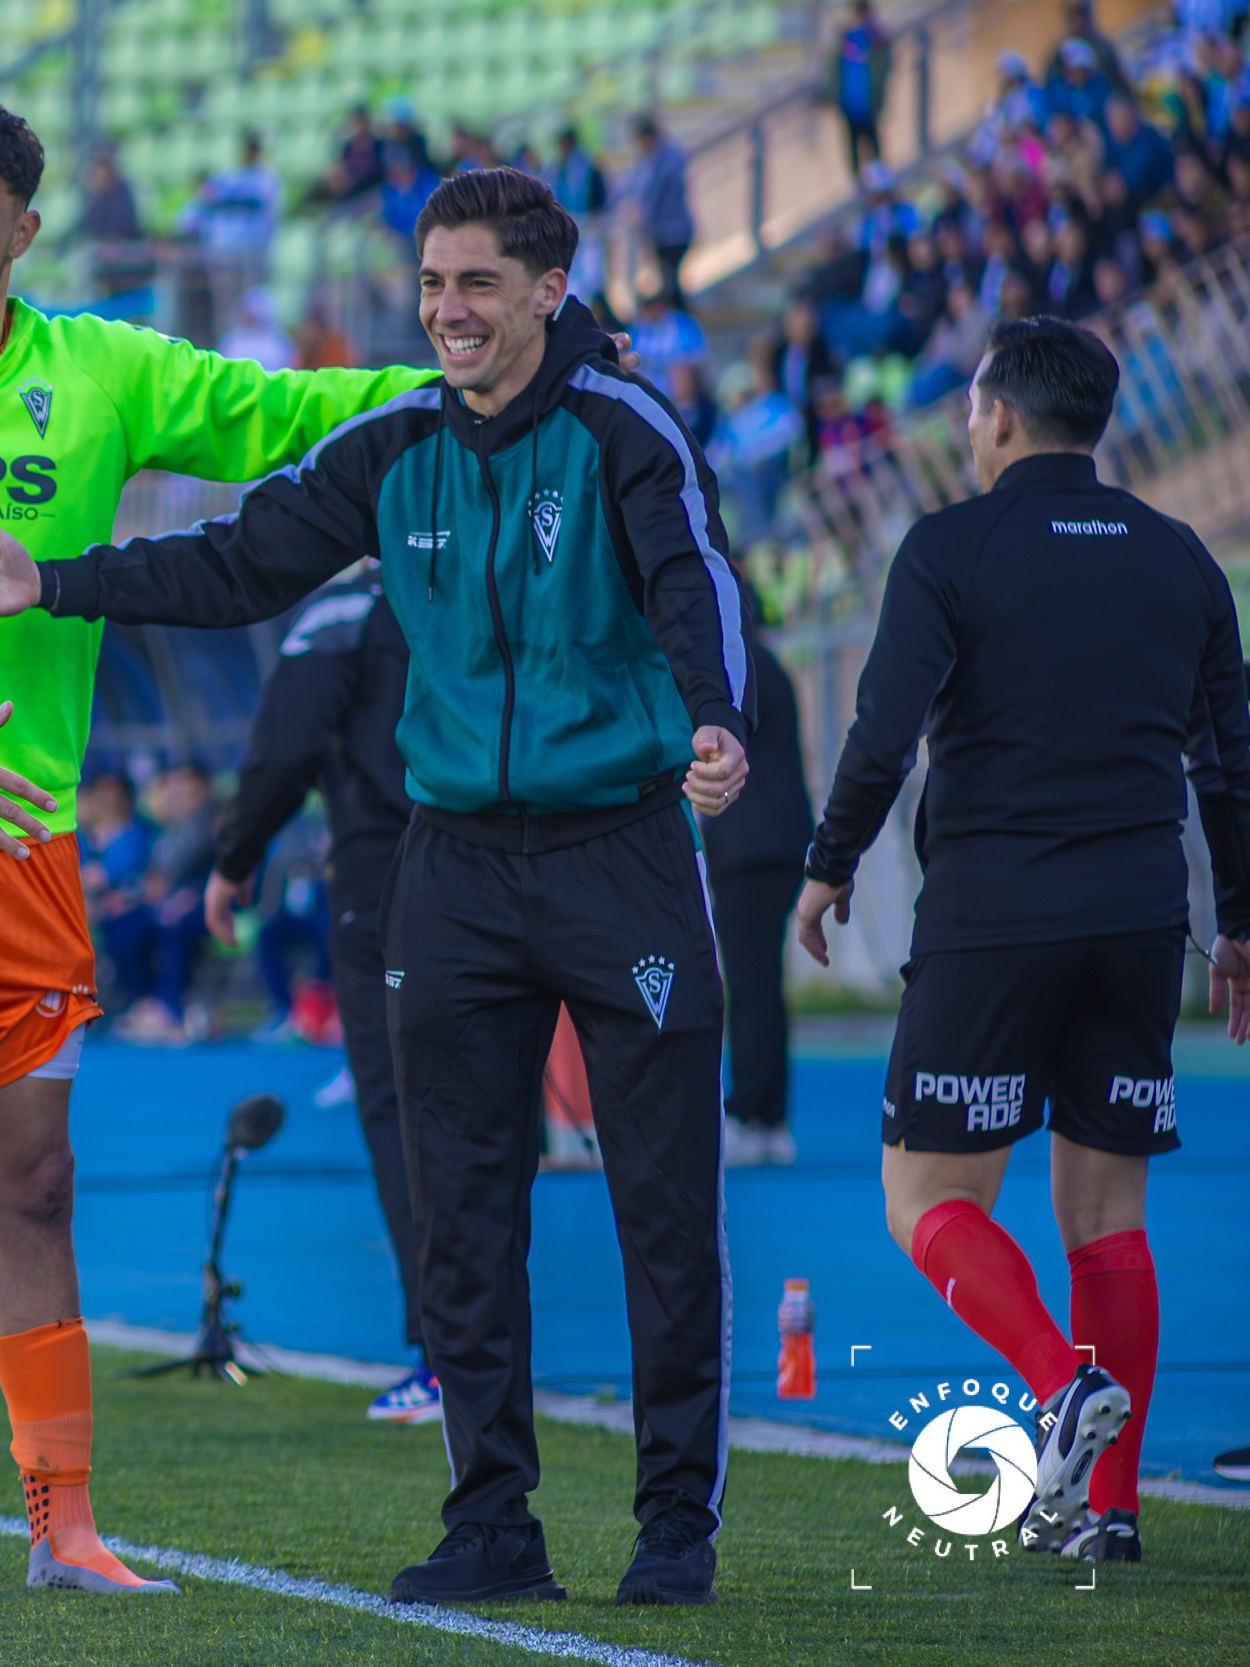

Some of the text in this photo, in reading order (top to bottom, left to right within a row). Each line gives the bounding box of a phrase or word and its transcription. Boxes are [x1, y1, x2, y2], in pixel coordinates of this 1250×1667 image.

[1051, 519, 1128, 535] marathon
[915, 1072, 1025, 1105] POWER
[967, 1103, 1021, 1132] ADE
